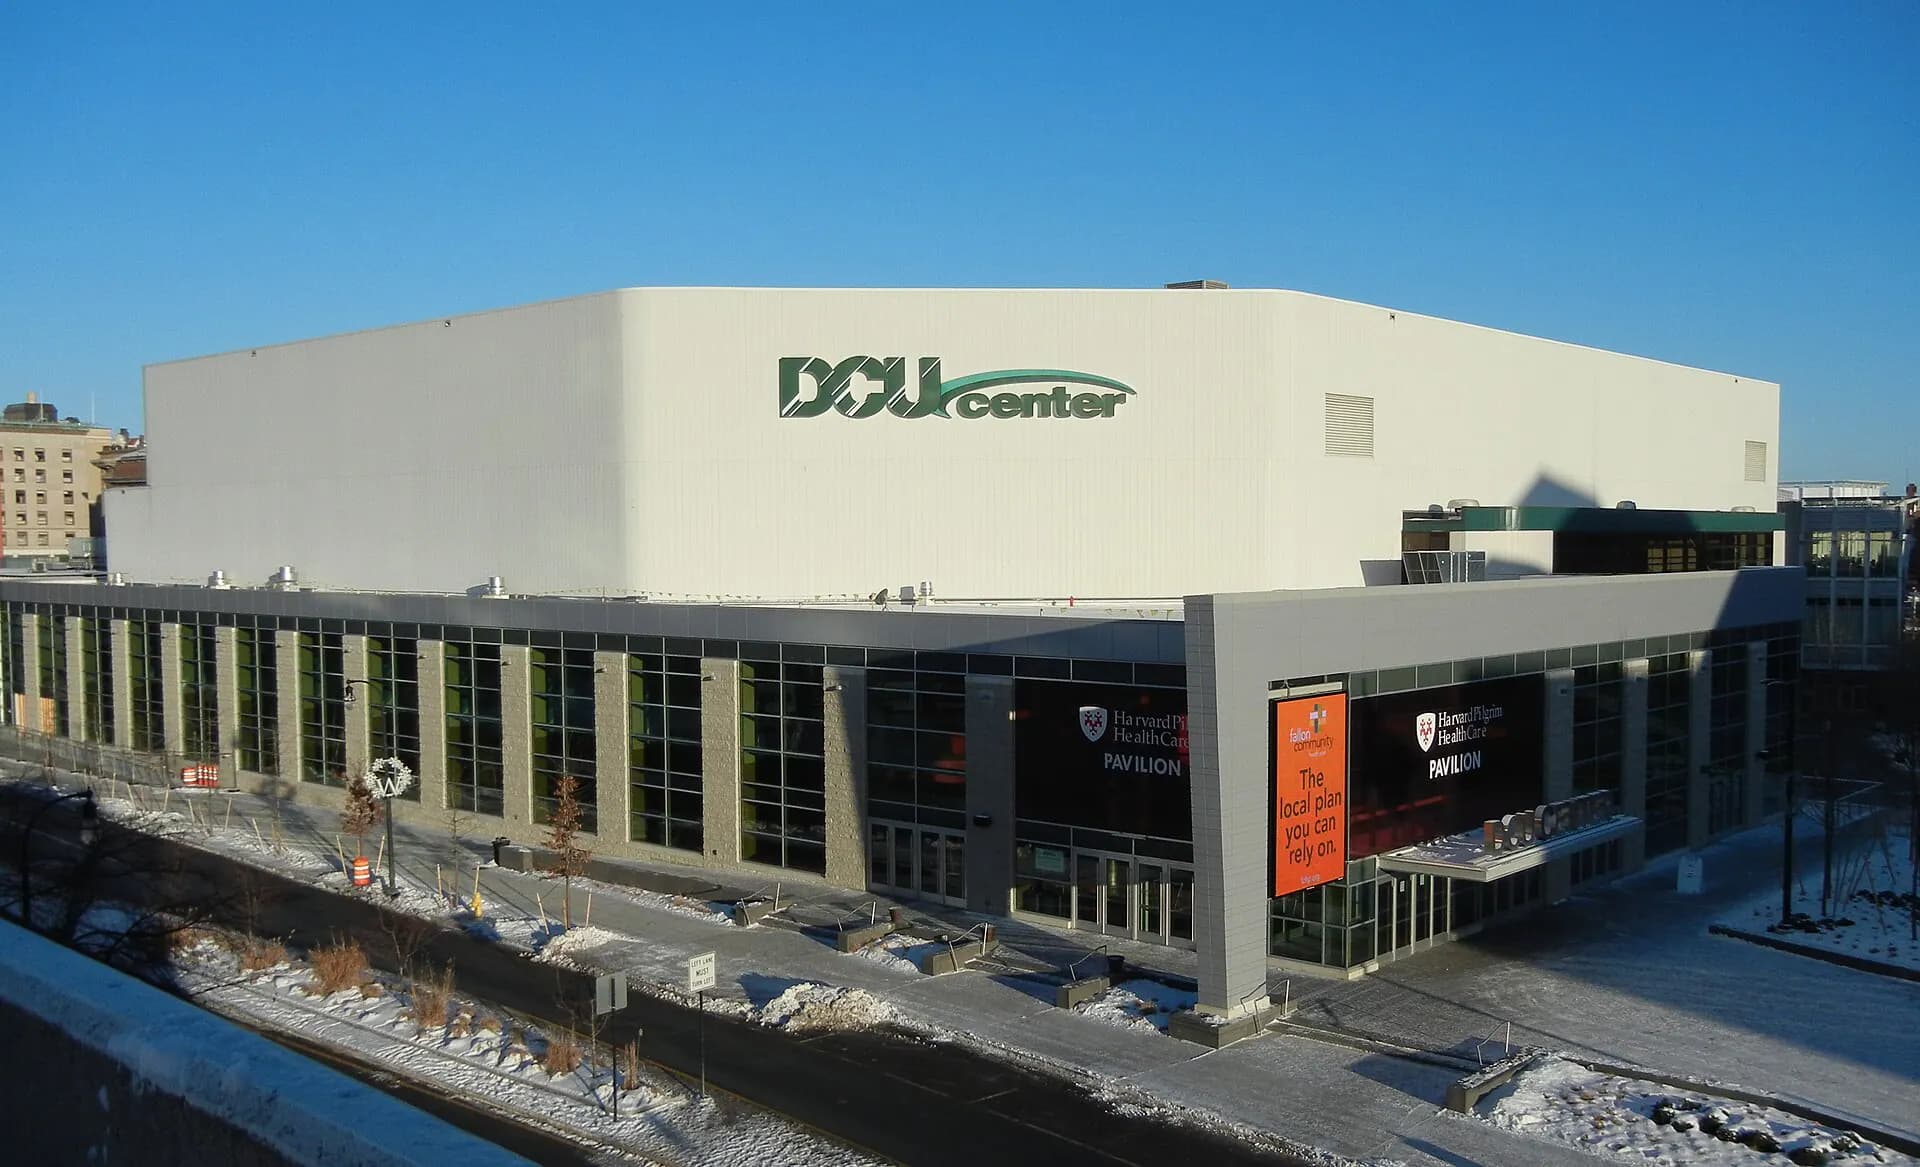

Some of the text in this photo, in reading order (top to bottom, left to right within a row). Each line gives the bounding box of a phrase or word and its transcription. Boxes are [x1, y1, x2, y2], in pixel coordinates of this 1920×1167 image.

[955, 386, 1127, 418] center
[1114, 710, 1170, 729] Harvard
[1438, 706, 1473, 728] Harvard
[1293, 735, 1334, 752] community
[1104, 752, 1181, 776] PAVILION
[1429, 750, 1481, 779] PAVILION
[1300, 768, 1324, 790] The
[1280, 788, 1342, 819] local plan
[1285, 815, 1336, 849] you can
[1289, 839, 1337, 868] rely on.
